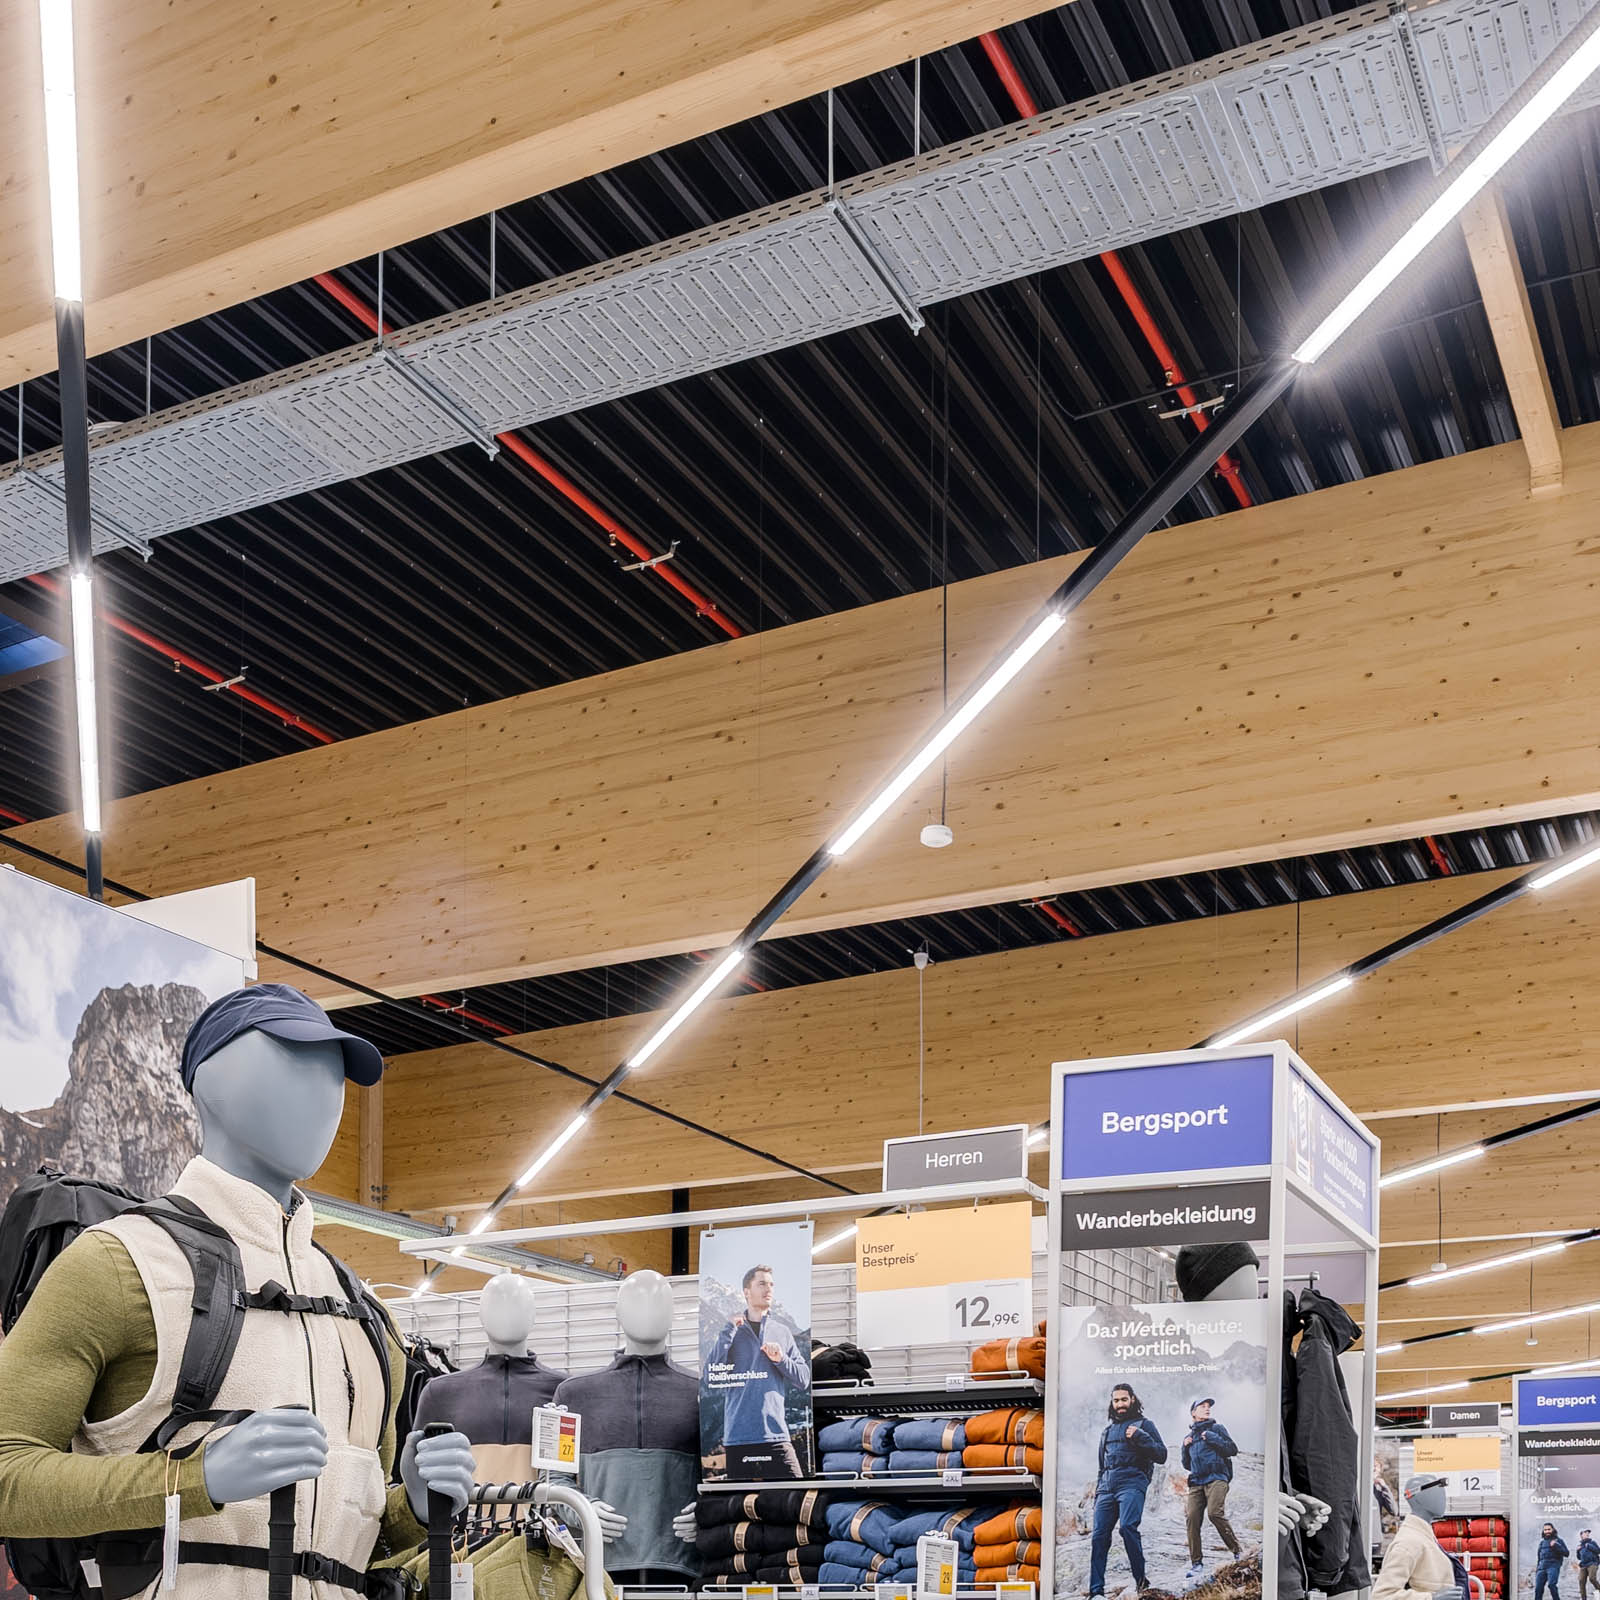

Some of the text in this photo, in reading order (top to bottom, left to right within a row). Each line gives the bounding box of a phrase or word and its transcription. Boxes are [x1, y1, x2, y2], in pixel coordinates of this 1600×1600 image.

[1102, 1104, 1228, 1135] Bergsport
[925, 1151, 983, 1169] Herren
[1076, 1205, 1257, 1230] Wanderbekleidung
[862, 1243, 894, 1254] Unser
[862, 1254, 915, 1268] Bestpreis
[955, 1296, 1020, 1328] 12,99€
[1087, 1320, 1243, 1338] Das Wetter heute:
[1113, 1339, 1196, 1360] sportlich.
[708, 1363, 735, 1372] Halber
[708, 1371, 768, 1381] Reißverschluss
[1536, 1394, 1597, 1408] Bergsport
[1450, 1411, 1481, 1420] Damen
